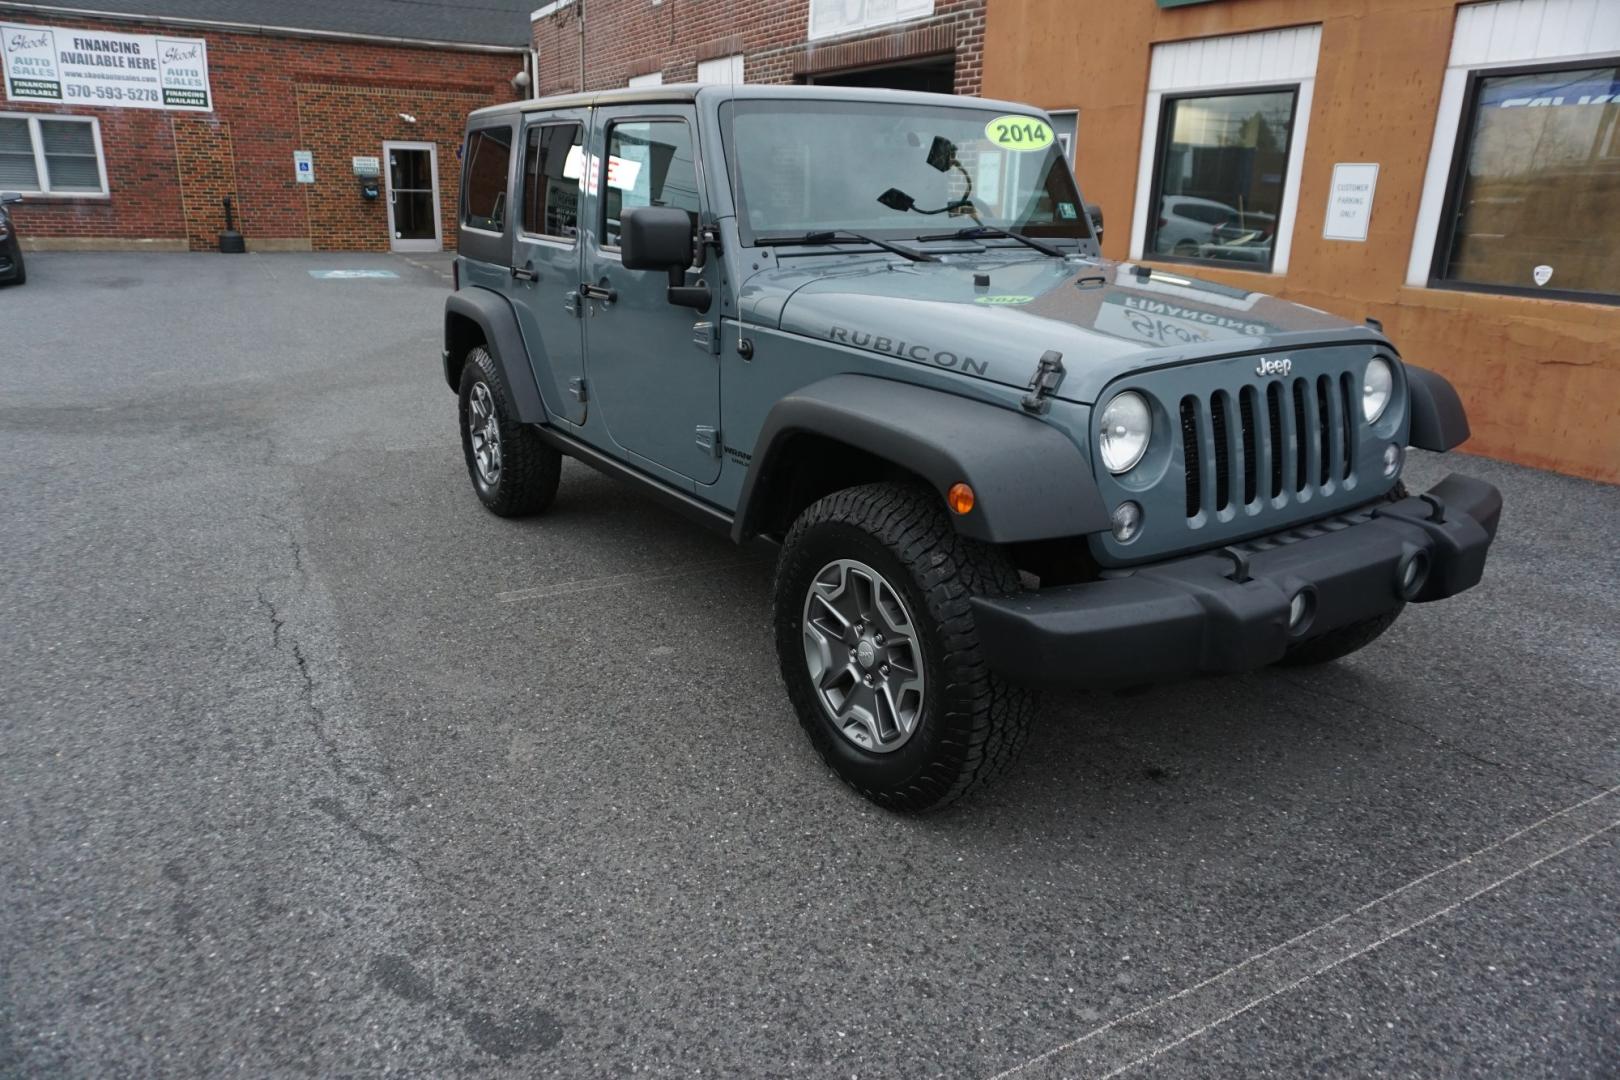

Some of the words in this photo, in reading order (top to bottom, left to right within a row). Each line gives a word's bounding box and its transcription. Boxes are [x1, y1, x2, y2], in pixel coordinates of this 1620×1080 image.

[8, 33, 48, 52] Skook
[73, 37, 140, 55] FINANCING
[162, 46, 197, 64] Skook
[14, 57, 50, 66] AUTO
[60, 52, 125, 68] AVAILABLE
[128, 57, 157, 70] HERE
[12, 66, 55, 77] SALES
[167, 68, 199, 77] AUTO
[13, 80, 58, 89] FINANCING
[164, 77, 202, 86] SALES
[15, 88, 58, 96] AVAILABLE
[66, 84, 158, 101] 570-593-5278
[165, 90, 205, 98] FINANCING
[166, 97, 205, 105] AVAILABLE
[997, 124, 1046, 142] 2014
[1337, 184, 1369, 192] CUSTOMER
[1337, 197, 1364, 205] PARKING
[1340, 210, 1357, 218] ONLY
[829, 326, 989, 376] RUBICON
[1256, 357, 1292, 377] Jeep
